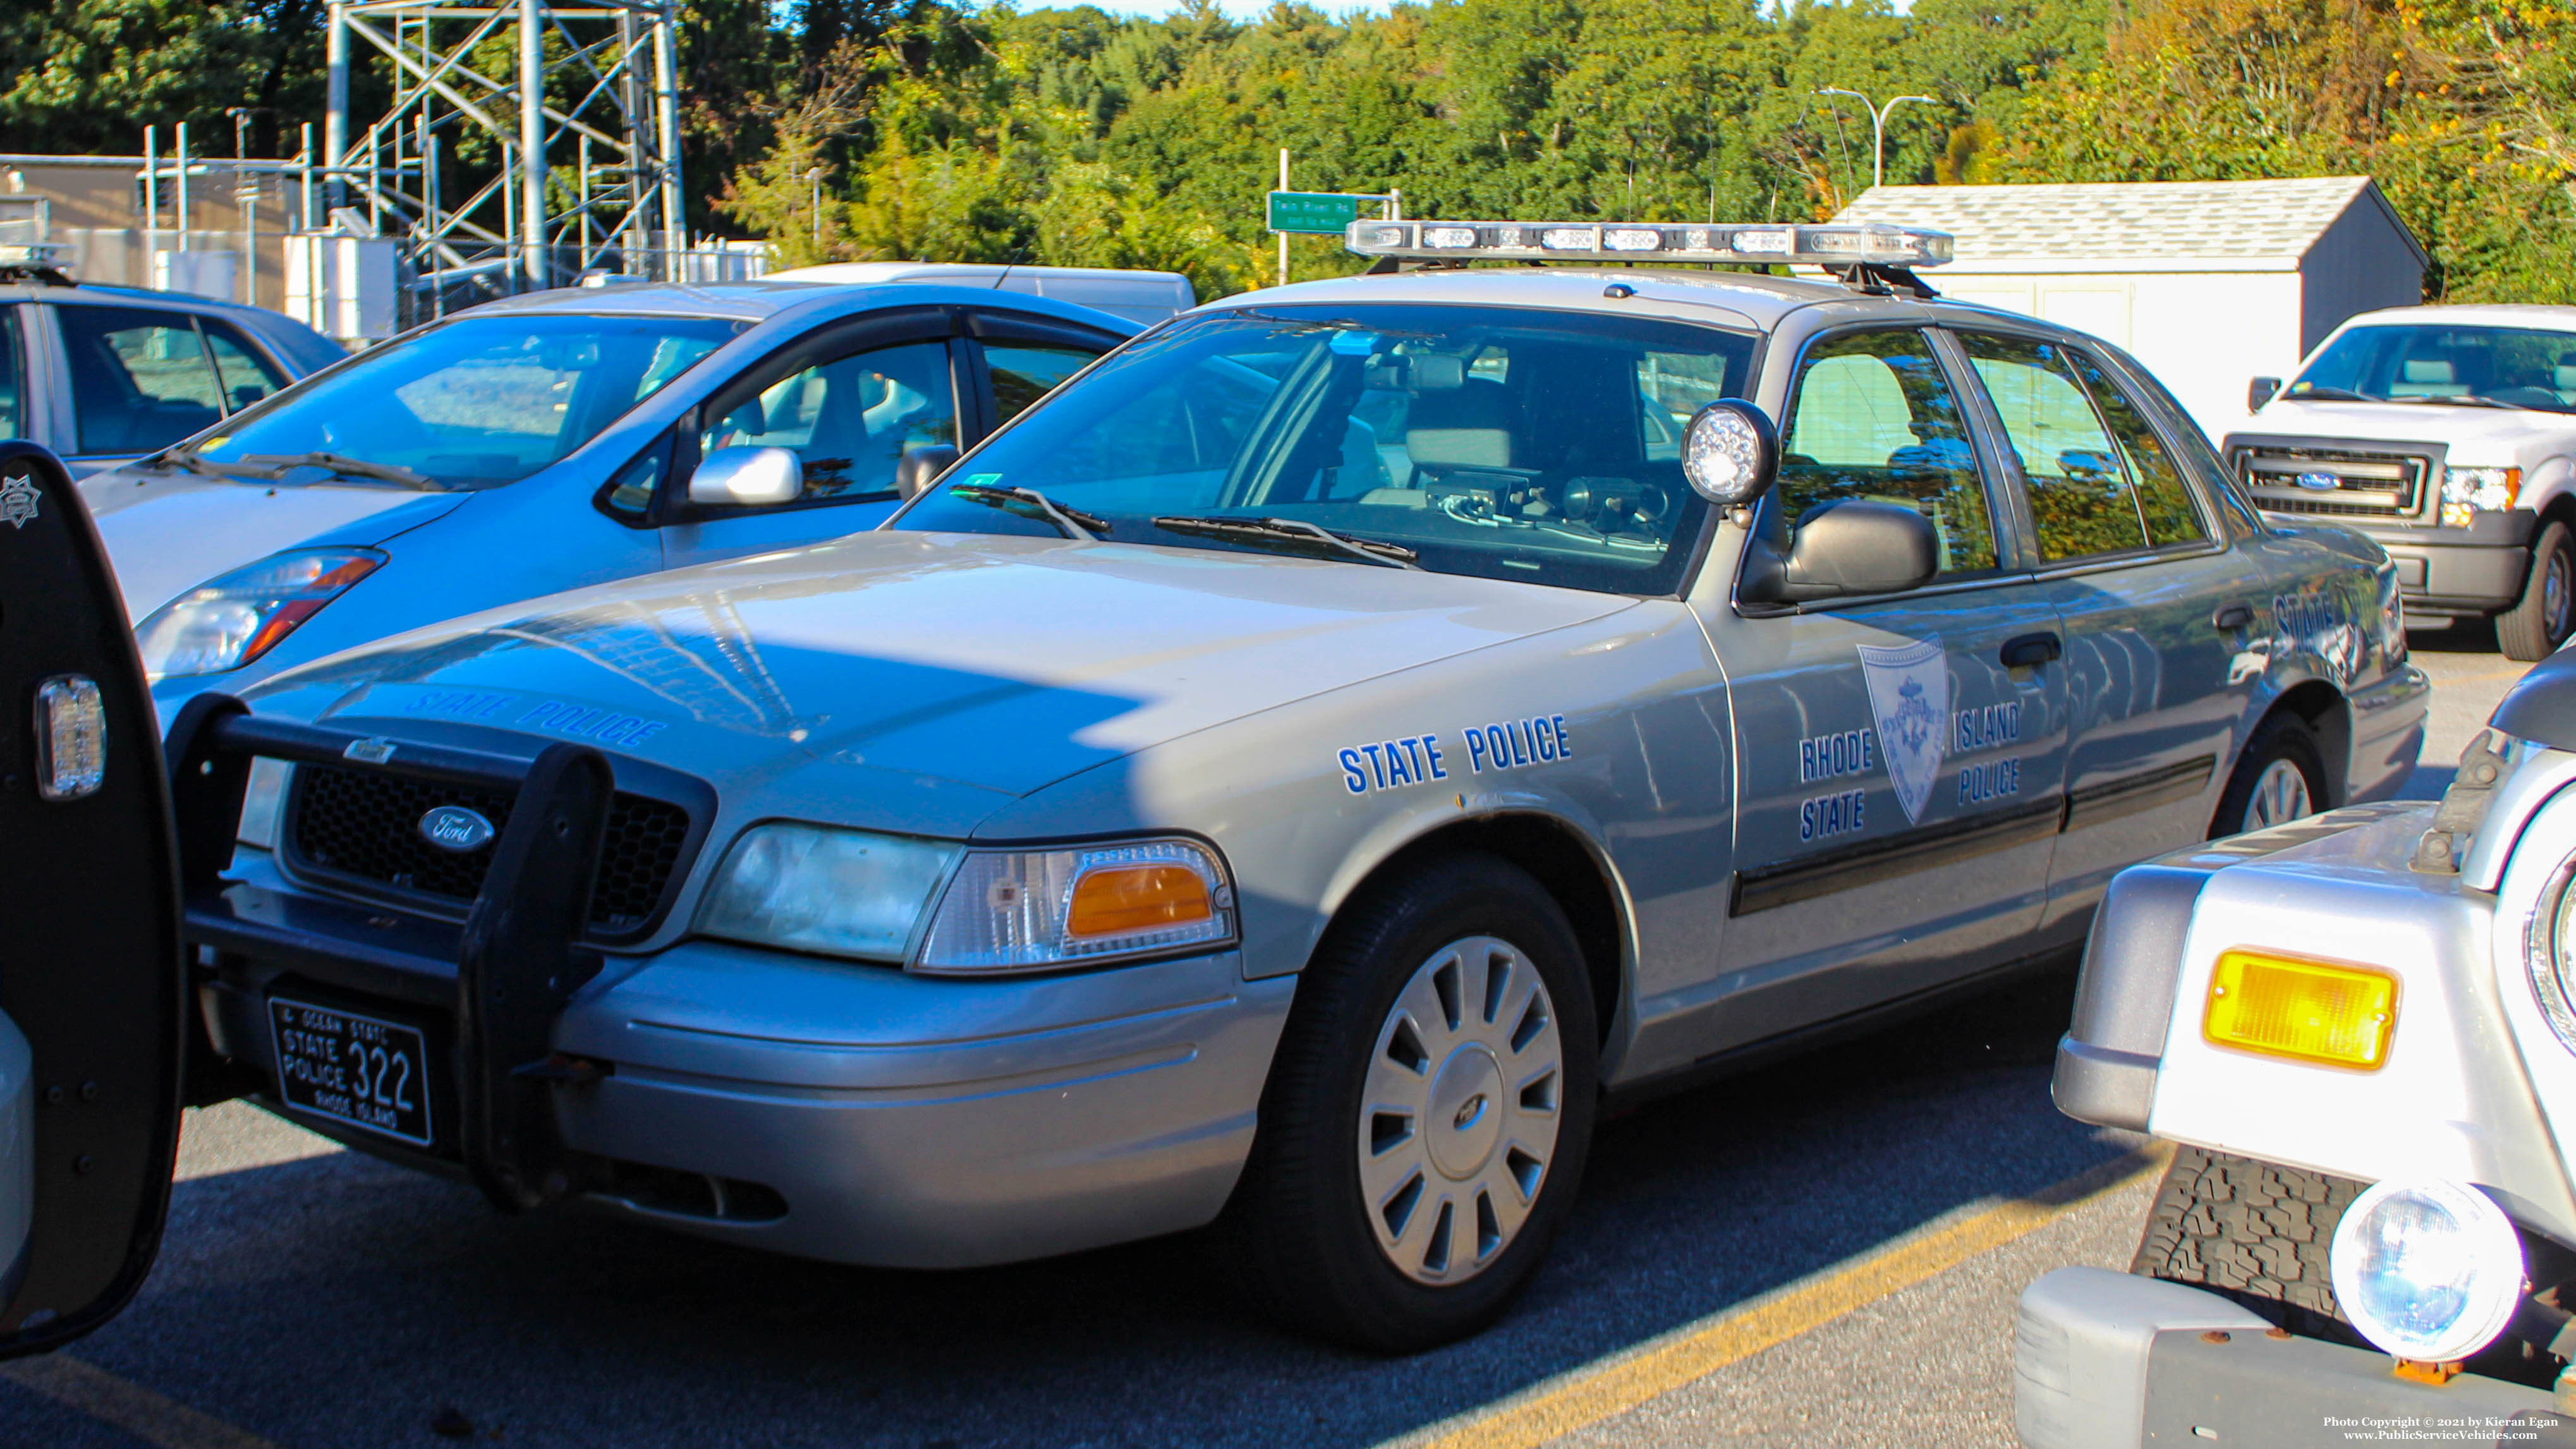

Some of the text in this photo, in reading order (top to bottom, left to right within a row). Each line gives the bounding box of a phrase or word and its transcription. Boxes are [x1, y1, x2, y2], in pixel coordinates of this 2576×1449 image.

[403, 691, 667, 748] STATE POLICE
[1799, 727, 1873, 784] RHODE
[1952, 701, 2020, 753] ISLAND
[1337, 713, 1572, 796] STATE POLICE
[1801, 758, 2020, 843] STATE POLICE
[432, 813, 474, 842] Ford
[283, 1029, 339, 1063] STATE
[302, 1010, 389, 1045] OCEAN STATE
[283, 1054, 347, 1091] POLICE
[348, 1040, 414, 1112] 322
[315, 1089, 398, 1129] RHODE ISLAND
